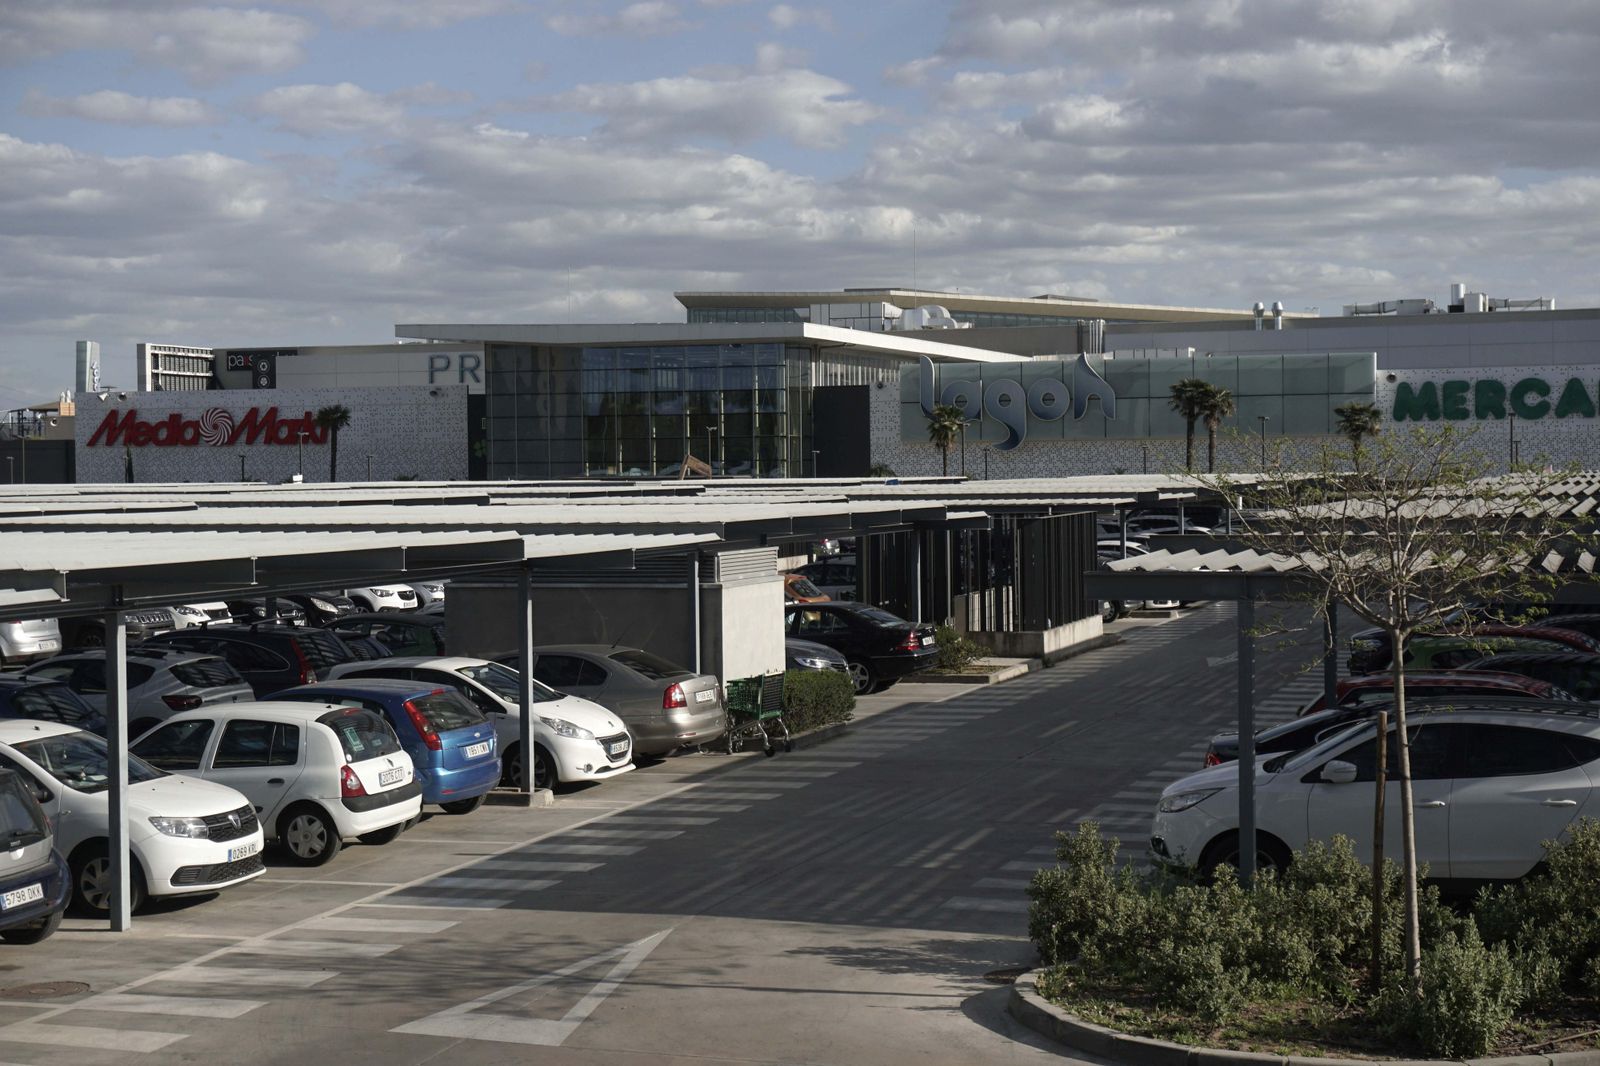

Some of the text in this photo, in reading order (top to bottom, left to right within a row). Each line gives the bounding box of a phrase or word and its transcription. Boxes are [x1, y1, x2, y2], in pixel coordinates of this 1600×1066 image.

[428, 354, 481, 385] PR
[920, 352, 1116, 451] lagoh
[1392, 377, 1600, 422] MERCA
[86, 408, 201, 447] Media
[232, 846, 248, 860] 0269
[6, 885, 42, 905] 5798 DKK
